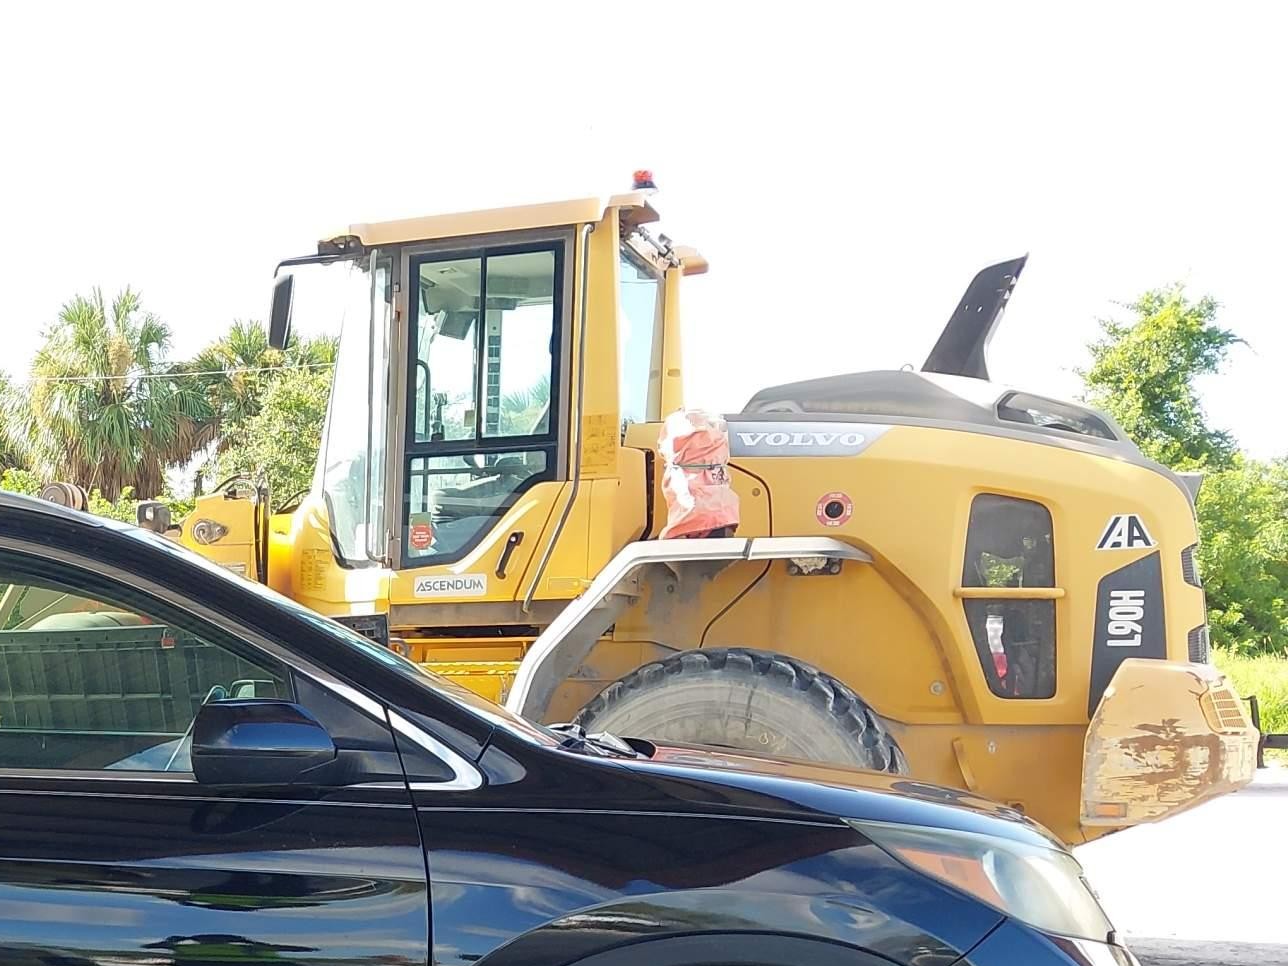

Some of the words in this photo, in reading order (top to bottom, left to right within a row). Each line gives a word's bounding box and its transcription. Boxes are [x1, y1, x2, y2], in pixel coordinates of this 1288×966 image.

[736, 432, 865, 446] VOLVO
[416, 579, 484, 592] ASCENDUM
[1107, 590, 1145, 647] L90H
